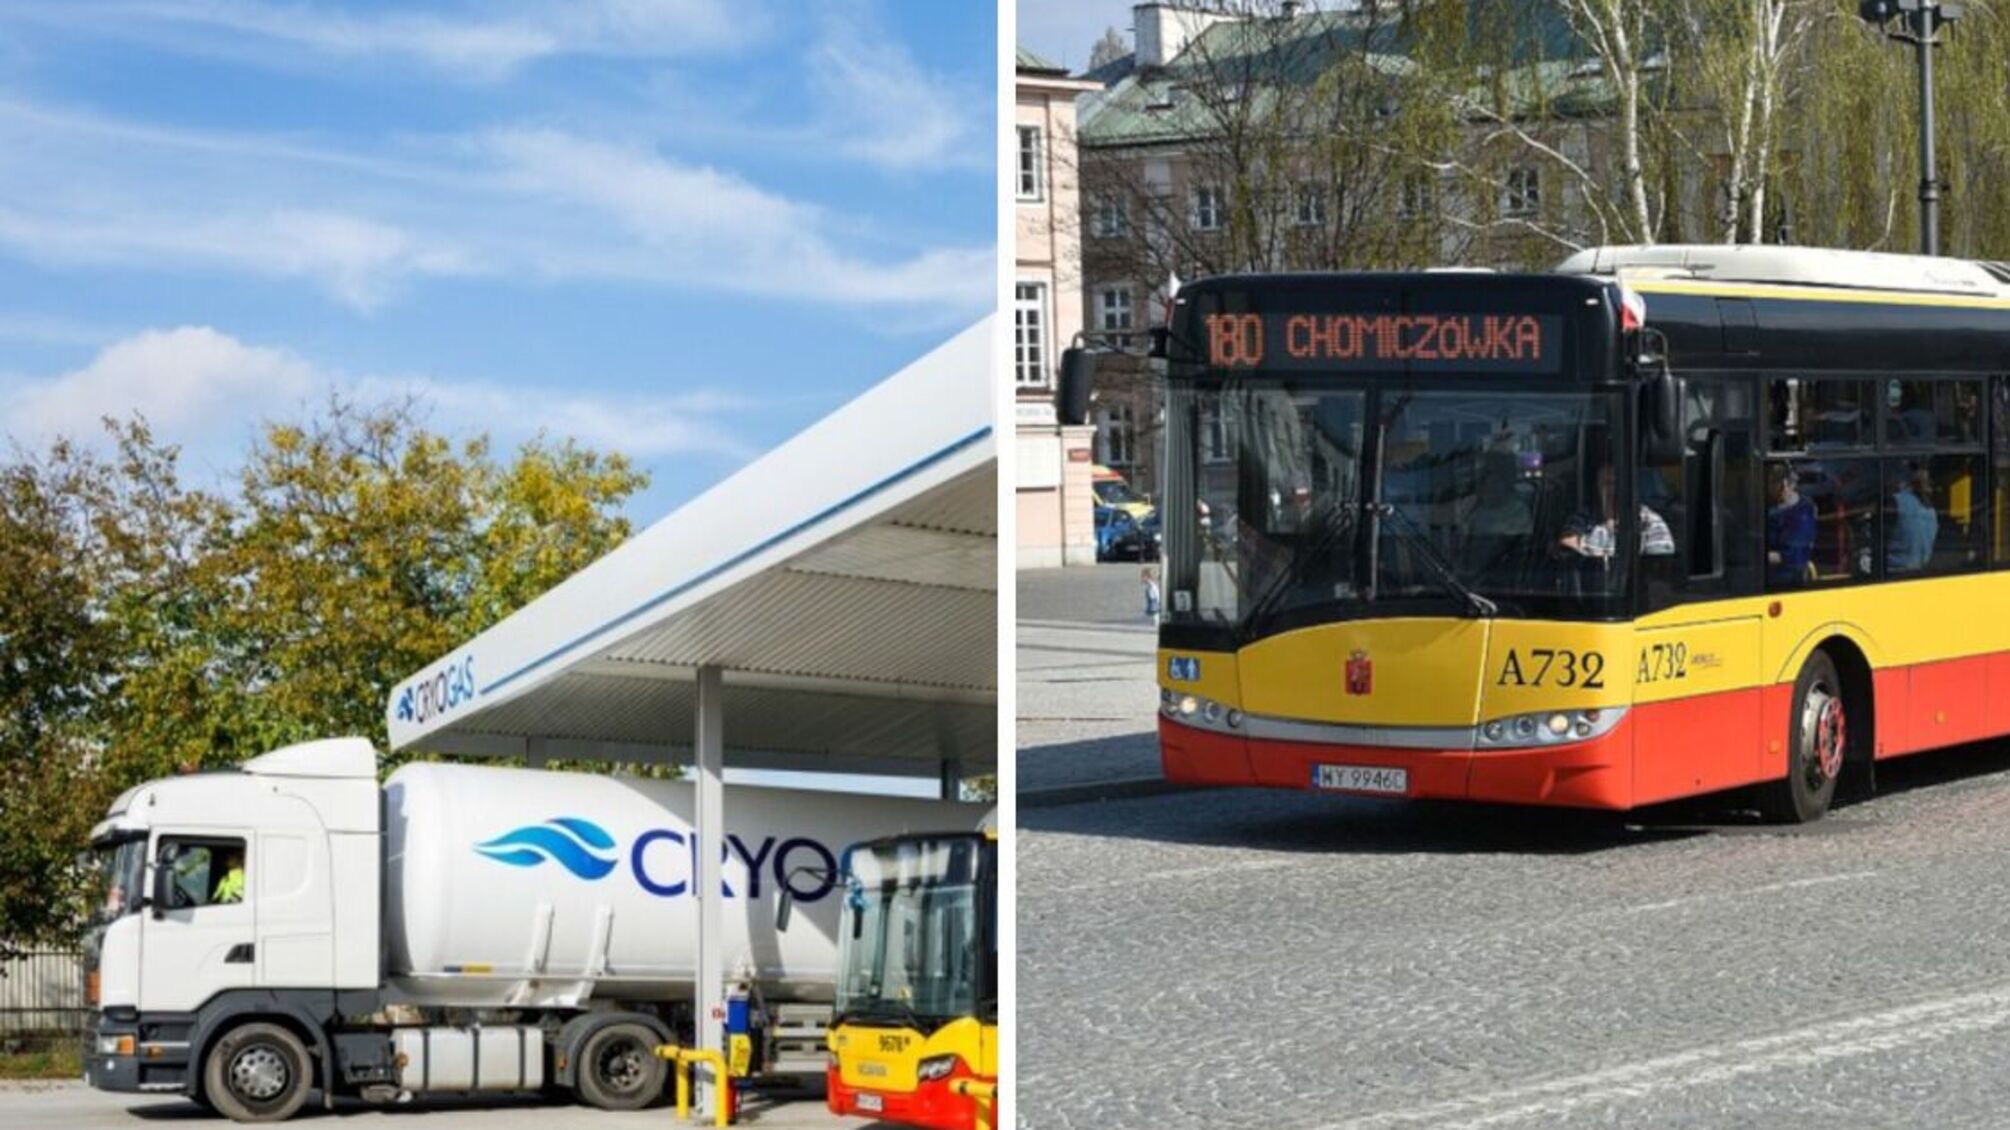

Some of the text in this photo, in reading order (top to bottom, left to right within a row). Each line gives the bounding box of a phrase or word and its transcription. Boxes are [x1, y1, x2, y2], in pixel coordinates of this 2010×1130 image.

[1205, 313, 1541, 366] 180 CHOMICZÓWKA
[1497, 648, 1605, 690] A732
[1636, 642, 1687, 684] A732
